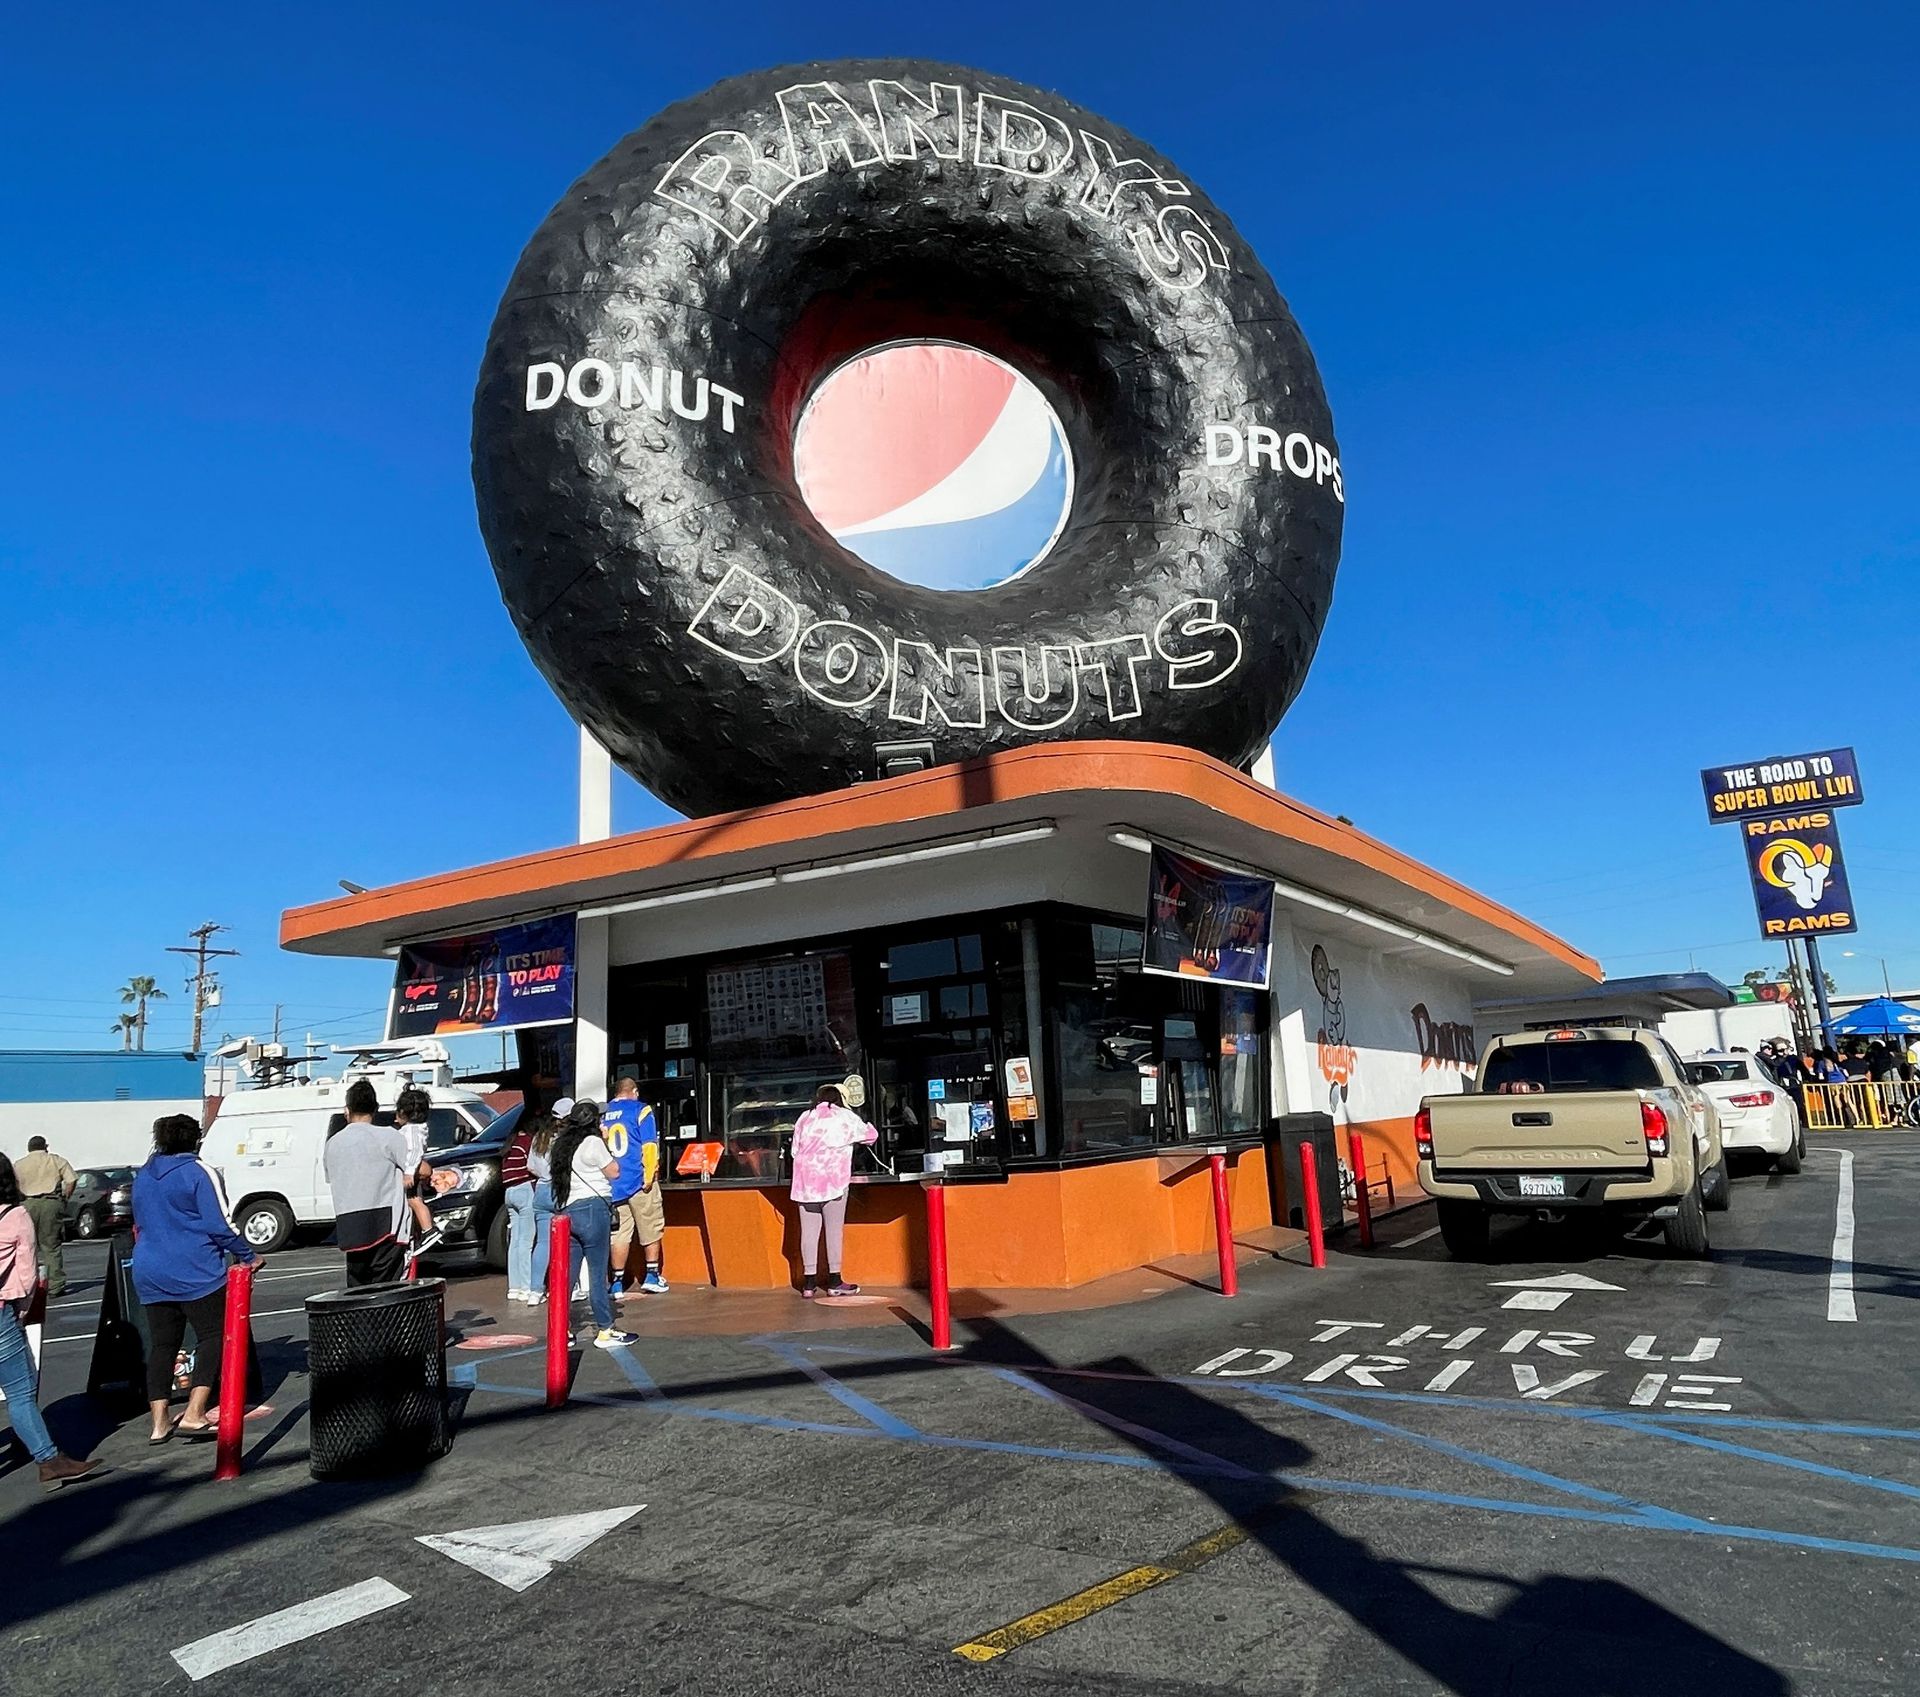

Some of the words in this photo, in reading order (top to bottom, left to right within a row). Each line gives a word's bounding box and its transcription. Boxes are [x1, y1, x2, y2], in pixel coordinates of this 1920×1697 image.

[653, 79, 1230, 291] RANDY'S
[524, 357, 745, 435] DONUT
[1204, 424, 1345, 503] DROPS
[686, 563, 1243, 731] DONUTS
[1724, 768, 1757, 790] THE
[1760, 760, 1807, 785] ROAD
[1809, 756, 1833, 776] TO
[1713, 788, 1768, 813] SUPER
[1771, 780, 1823, 805] BOWL
[1826, 775, 1855, 797] LVI
[1747, 813, 1831, 836] RAMS
[1766, 912, 1851, 933] RAMS
[506, 953, 530, 970] IT'S
[509, 970, 527, 985] TO
[529, 965, 562, 983] PLAY
[1478, 1151, 1601, 1161] TACOMA
[1309, 1319, 1722, 1362] THRU
[1190, 1347, 1743, 1411] DRIVE
